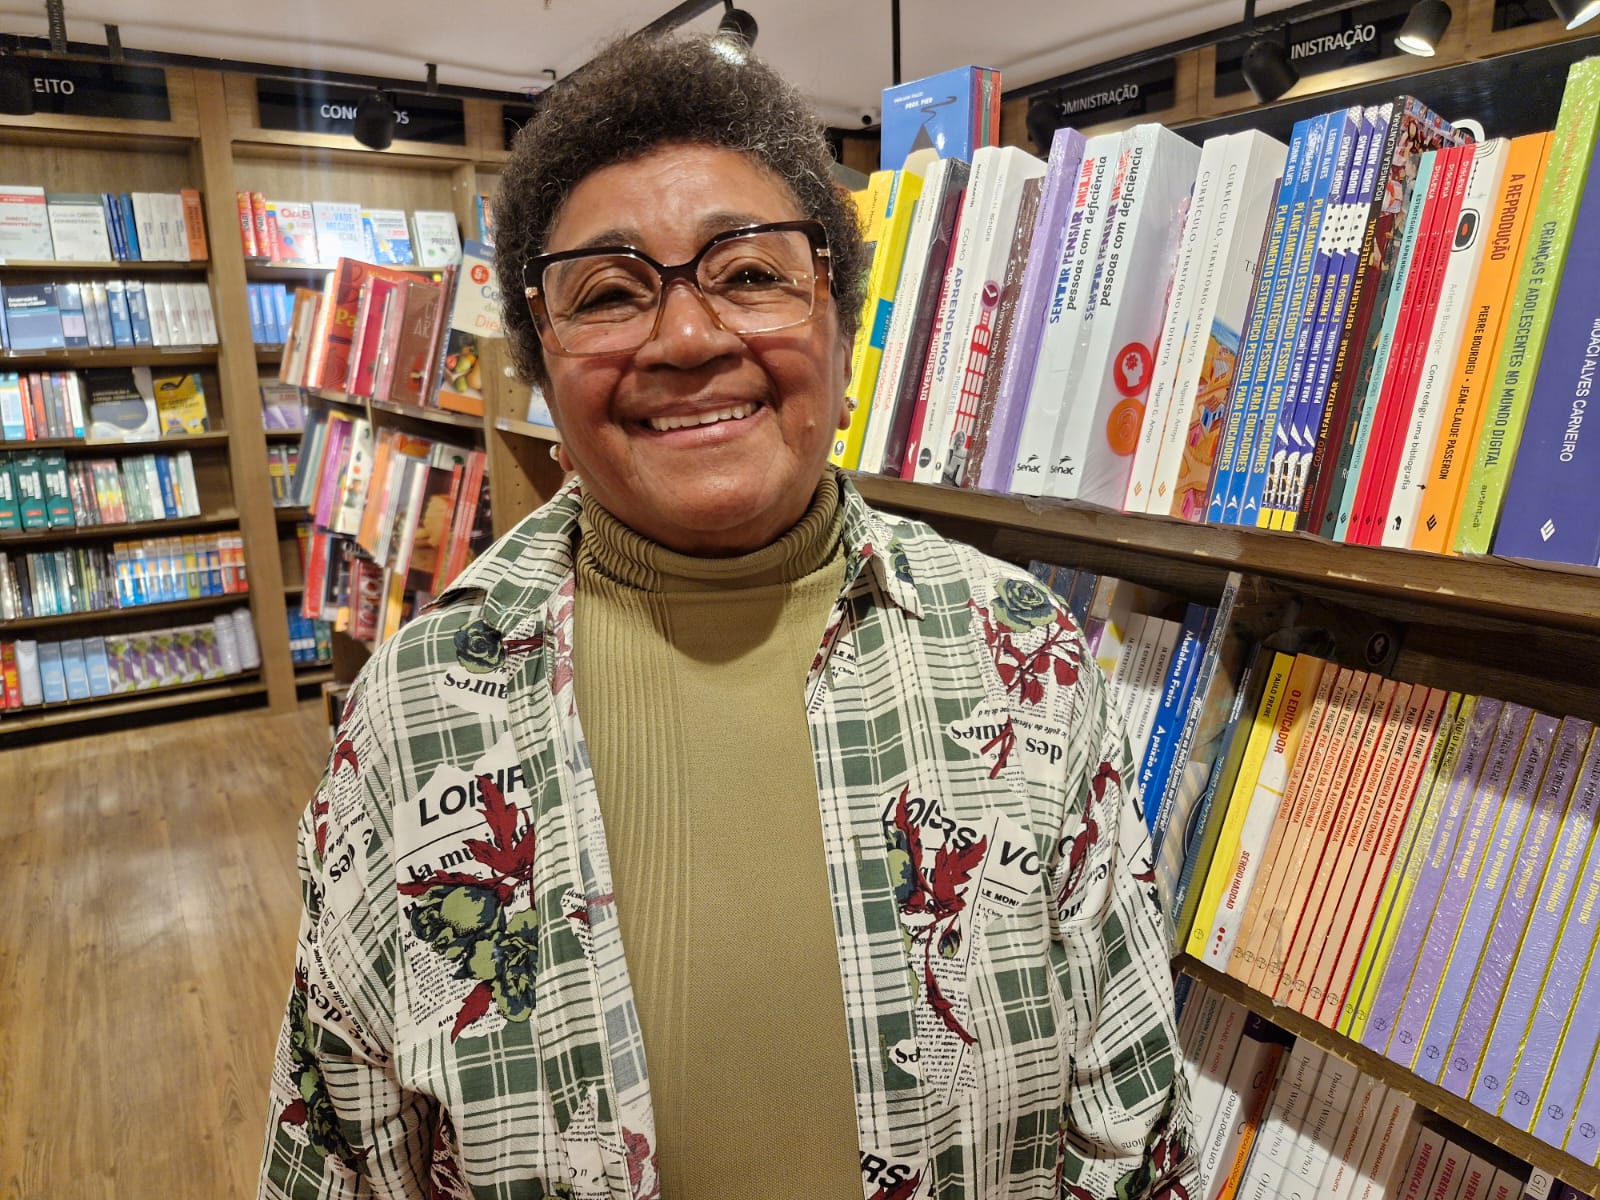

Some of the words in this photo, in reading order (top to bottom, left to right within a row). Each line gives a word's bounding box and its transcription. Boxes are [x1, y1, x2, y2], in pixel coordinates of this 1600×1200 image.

[33, 77, 75, 95] EITO
[1060, 84, 1139, 116] DMINISTRAÇÃO
[1084, 156, 1107, 224] deficiência
[1284, 164, 1296, 187] ALVES
[1375, 156, 1391, 201] ROSANGELA
[1429, 165, 1442, 200] DISLEXIA
[1442, 164, 1455, 198] DISLEXIA
[1456, 161, 1469, 196] DISLEXIA
[1050, 264, 1072, 324] SENTIR
[1062, 210, 1084, 265] PENSAR
[1075, 158, 1095, 208] INCLUIR
[1080, 229, 1091, 254] com
[1100, 253, 1119, 307] pessoas
[1113, 221, 1127, 249] com
[1123, 147, 1143, 218] deficiência
[1264, 205, 1289, 277] PLANEJAMENTO
[1279, 202, 1305, 276] PLANEJAMENTO
[1299, 198, 1324, 273] PLANEJAMENTO
[1491, 185, 1522, 261] REPRODUÇÃO
[959, 228, 971, 261] COMO
[1085, 263, 1104, 321] SENTIR
[1098, 202, 1118, 262] PENSAR
[1532, 221, 1556, 274] CRIANÇAS
[481, 285, 500, 301] Ce
[1067, 259, 1084, 310] pessoas
[1174, 248, 1192, 308] TERRITÓRIO
[1200, 243, 1218, 305] TERRITÓRIO
[1340, 272, 1350, 287] LER
[995, 299, 1008, 337] INVASIVA
[1249, 277, 1272, 341] ESTRATÉGICO
[1265, 277, 1288, 341] ESTRATÉGICO
[1284, 272, 1308, 339] ESTRATÉGICO
[1333, 287, 1346, 316] PRECISO
[1475, 305, 1490, 336] PIERRE
[936, 268, 965, 382] APRENDEMOS?
[1313, 440, 1325, 467] COMO
[1320, 382, 1340, 439] ALFABETIZAR
[1335, 339, 1349, 372] LETRAR
[1345, 279, 1363, 330] DEFICIENTE
[1358, 218, 1377, 277] INTELECTUAL
[1509, 287, 1541, 368] ADOLESCENTES
[1585, 318, 1600, 357] MOACI
[992, 338, 1000, 357] NÃO
[1161, 326, 1175, 367] DISPUTA
[1187, 326, 1201, 364] DISPUTA
[1240, 344, 1257, 383] PESSOAL
[1255, 343, 1272, 384] PESSOAL
[1274, 342, 1292, 383] PESSOAL
[1467, 338, 1483, 375] BOURDIEU
[873, 341, 893, 410] PEDAGÓGICA
[884, 341, 904, 410] PEDAGÓGICA
[920, 334, 940, 401] DIVERSIDADE
[1318, 363, 1329, 384] AMAR
[1425, 364, 1438, 389] Como
[1509, 371, 1520, 384] NO
[1576, 360, 1598, 397] ALVES
[1153, 382, 1165, 409] Miguel
[1232, 386, 1245, 410] PARA
[1248, 386, 1261, 411] PARA
[1268, 385, 1282, 410] PARA
[1313, 385, 1324, 404] PARA
[1418, 391, 1431, 419] redigir
[1452, 384, 1470, 437] JEAN-CLAUDE
[1496, 388, 1515, 427] MUNDO
[1220, 413, 1242, 471] EDUCADORES
[1235, 414, 1257, 473] EDUCADORES
[1253, 414, 1276, 474] EDUCADORES
[1413, 421, 1423, 440] uma
[1484, 430, 1506, 468] DIGITAL
[1560, 400, 1587, 462] CARNEIRO
[1401, 442, 1420, 490] bibliografia
[1438, 440, 1458, 480] PASSERON
[1171, 630, 1194, 677] Madalena
[1164, 679, 1182, 708] Freire
[1270, 673, 1282, 695] PAULO
[1263, 696, 1277, 718] FREIRE
[1402, 706, 1418, 731] PAULO
[1420, 708, 1435, 734] PAULO
[1273, 700, 1299, 754] EDUCADOR
[1393, 731, 1409, 757] FREIRE
[1411, 733, 1427, 760] FREIRE
[1025, 737, 1063, 764] des
[1146, 735, 1160, 767] paixão
[1558, 741, 1575, 769] PAULO
[1143, 769, 1152, 781] de
[1171, 766, 1182, 788] fazem
[1364, 754, 1385, 794] PEDAGOGIA
[1379, 757, 1400, 798] PEDAGOGIA
[1397, 759, 1418, 801] PEDAGOGIA
[1547, 768, 1565, 798] FREIRE
[1346, 806, 1367, 848] AUTONOMIA
[1360, 809, 1382, 853] AUTONOMIA
[1377, 813, 1400, 857] AUTONOMIA
[407, 861, 434, 882] la
[1236, 851, 1250, 879] SERGIO
[1455, 840, 1478, 879] OPRIMIDO
[1513, 857, 1536, 898] OPRIMIDO
[981, 888, 994, 898] LE
[1226, 879, 1242, 909] HADDAD
[309, 984, 343, 1023] des
[1294, 1055, 1310, 1081] Daniel
[1201, 1088, 1242, 1170] contemporâneos
[861, 1151, 911, 1190] RS
